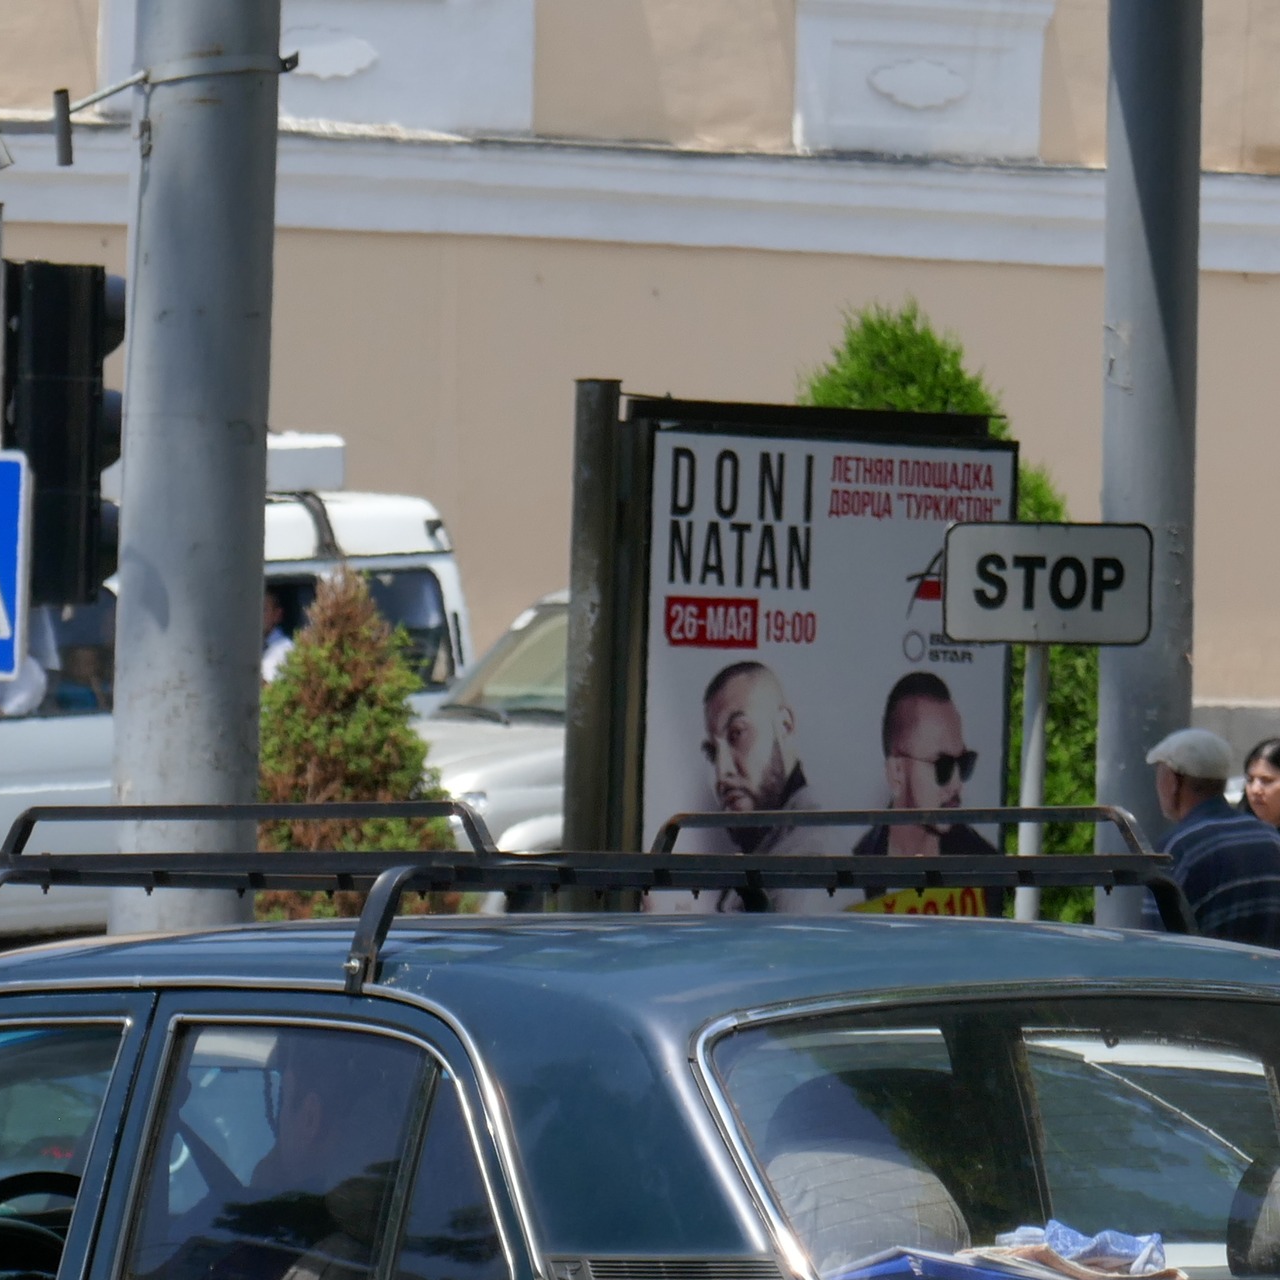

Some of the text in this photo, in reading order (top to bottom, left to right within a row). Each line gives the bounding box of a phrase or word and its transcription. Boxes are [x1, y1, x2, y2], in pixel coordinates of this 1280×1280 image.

[670, 446, 814, 522] DONI
[830, 454, 994, 491] ЛЕТНЯЯ ПЛОЩАДКА
[828, 488, 893, 519] ДВОРЦА
[668, 519, 811, 590] NATAN
[974, 553, 1125, 611] STOP
[669, 604, 817, 644] 26-МАЯ 19:00
